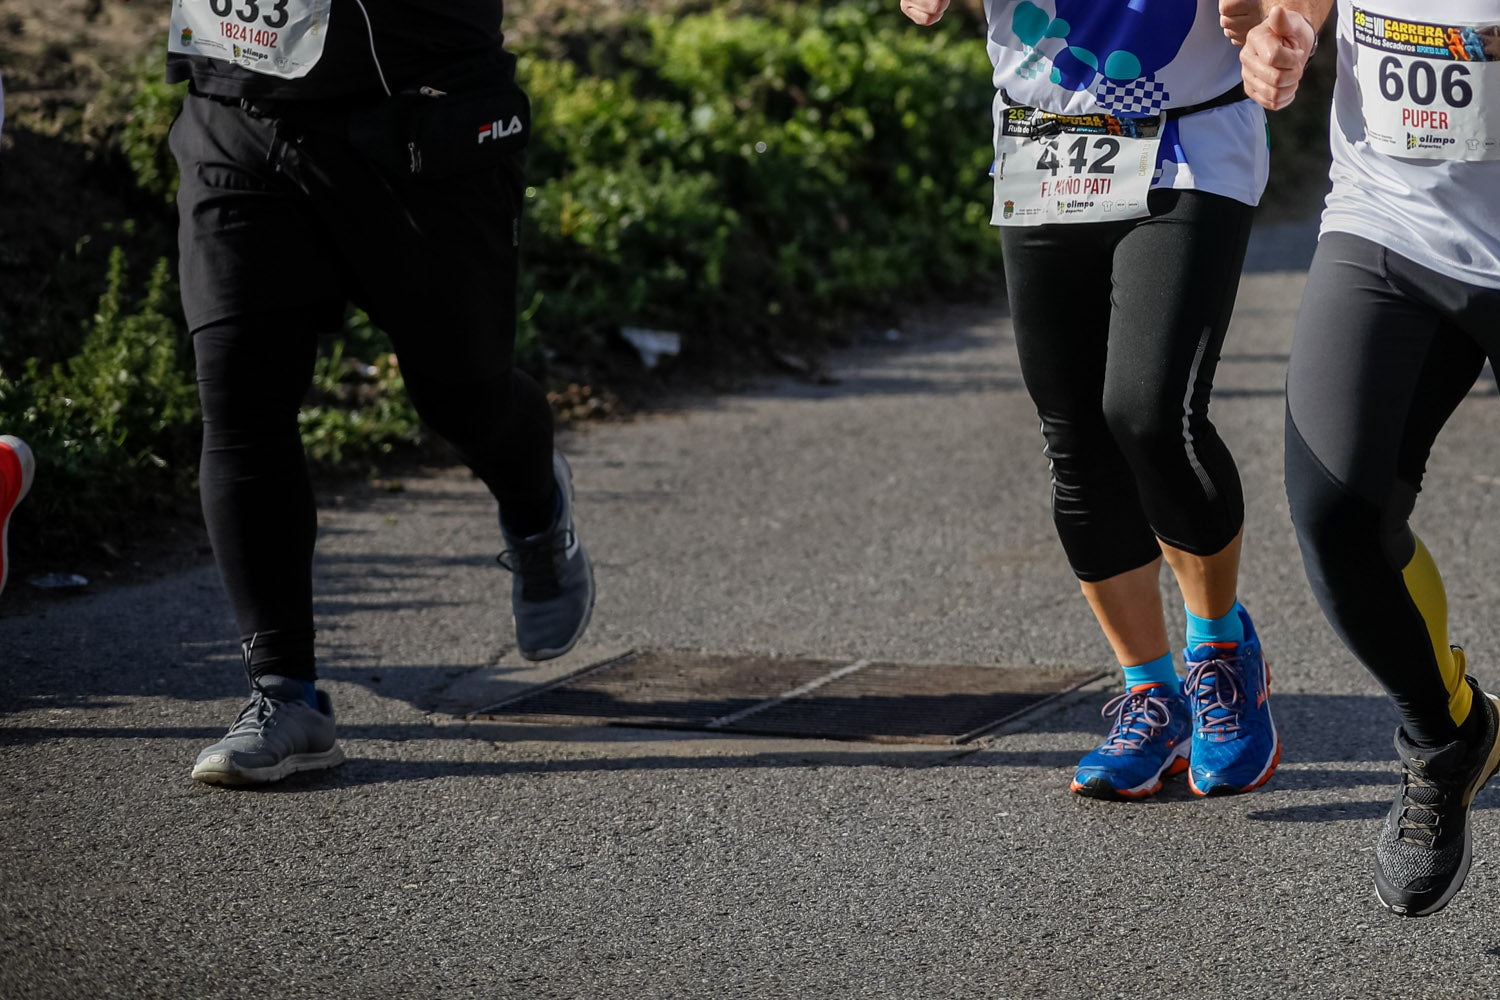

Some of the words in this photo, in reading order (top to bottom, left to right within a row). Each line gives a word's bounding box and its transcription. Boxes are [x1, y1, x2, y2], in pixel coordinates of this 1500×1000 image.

[1354, 11, 1366, 27] 26
[219, 21, 279, 49] 18241402
[1384, 19, 1444, 38] CARRERA
[1372, 36, 1381, 46] los
[1382, 38, 1416, 52] Secaderos
[1384, 30, 1445, 47] POPULAR
[242, 47, 268, 60] olimpo
[1379, 55, 1473, 109] 606
[1008, 108, 1025, 120] 26
[1402, 108, 1449, 130] PUPER
[478, 115, 523, 144] FILA
[1008, 125, 1022, 133] Ruta
[1022, 126, 1030, 134] de
[1419, 134, 1456, 146] olimpo
[1036, 136, 1121, 177] 442
[1083, 178, 1111, 195] PATI
[1066, 200, 1094, 209] olimpo
